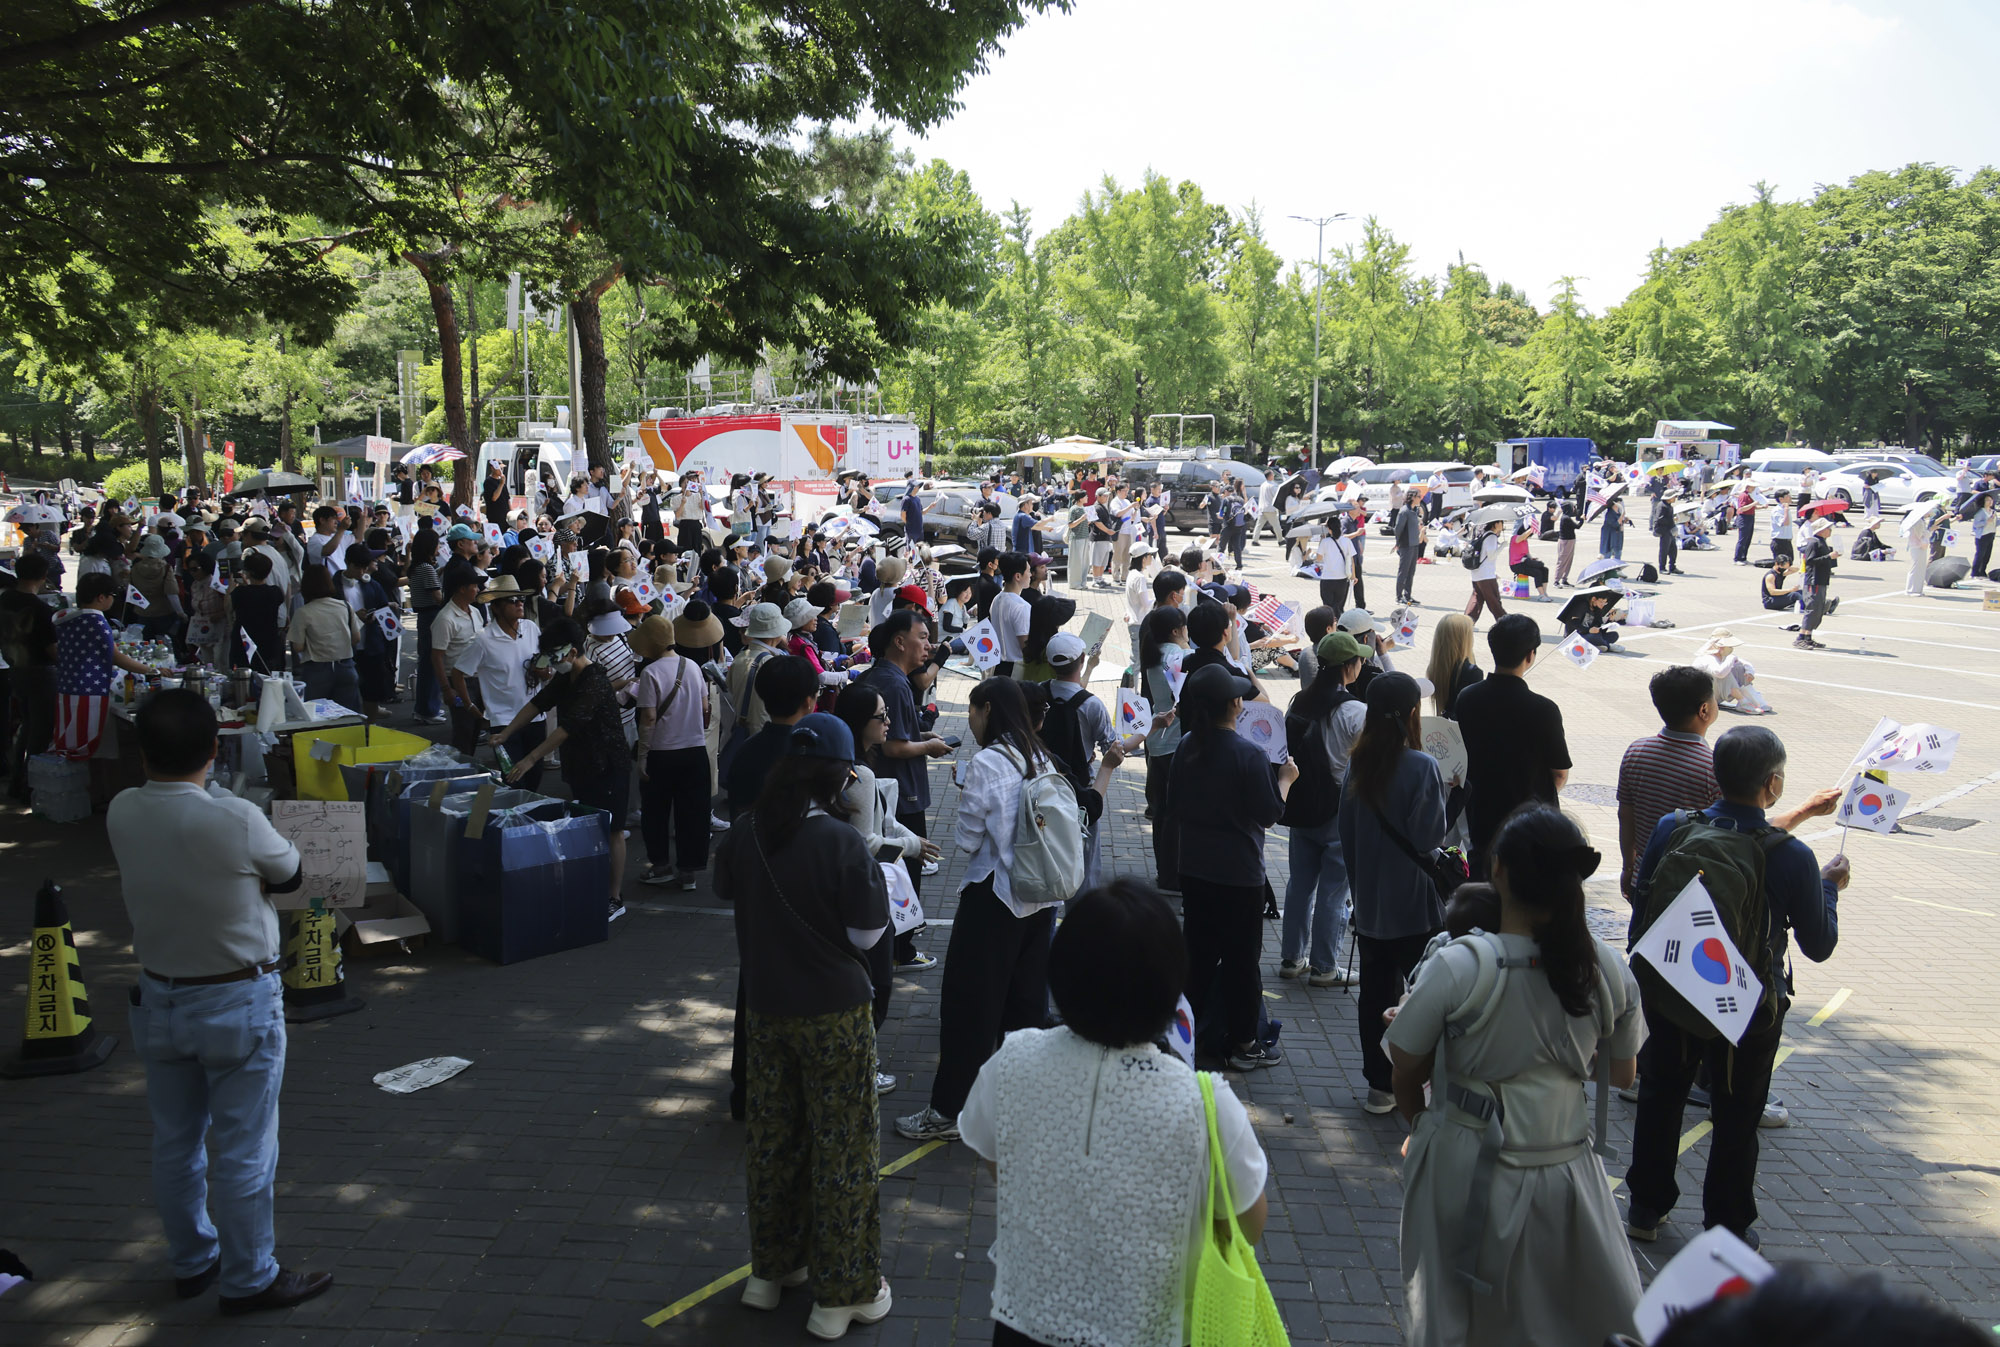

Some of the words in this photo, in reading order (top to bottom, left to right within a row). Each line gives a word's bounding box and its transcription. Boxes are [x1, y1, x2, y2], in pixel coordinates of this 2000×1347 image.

[888, 440, 914, 460] U+
[305, 912, 322, 983] 주차금지
[37, 954, 57, 1032] 주차금지
